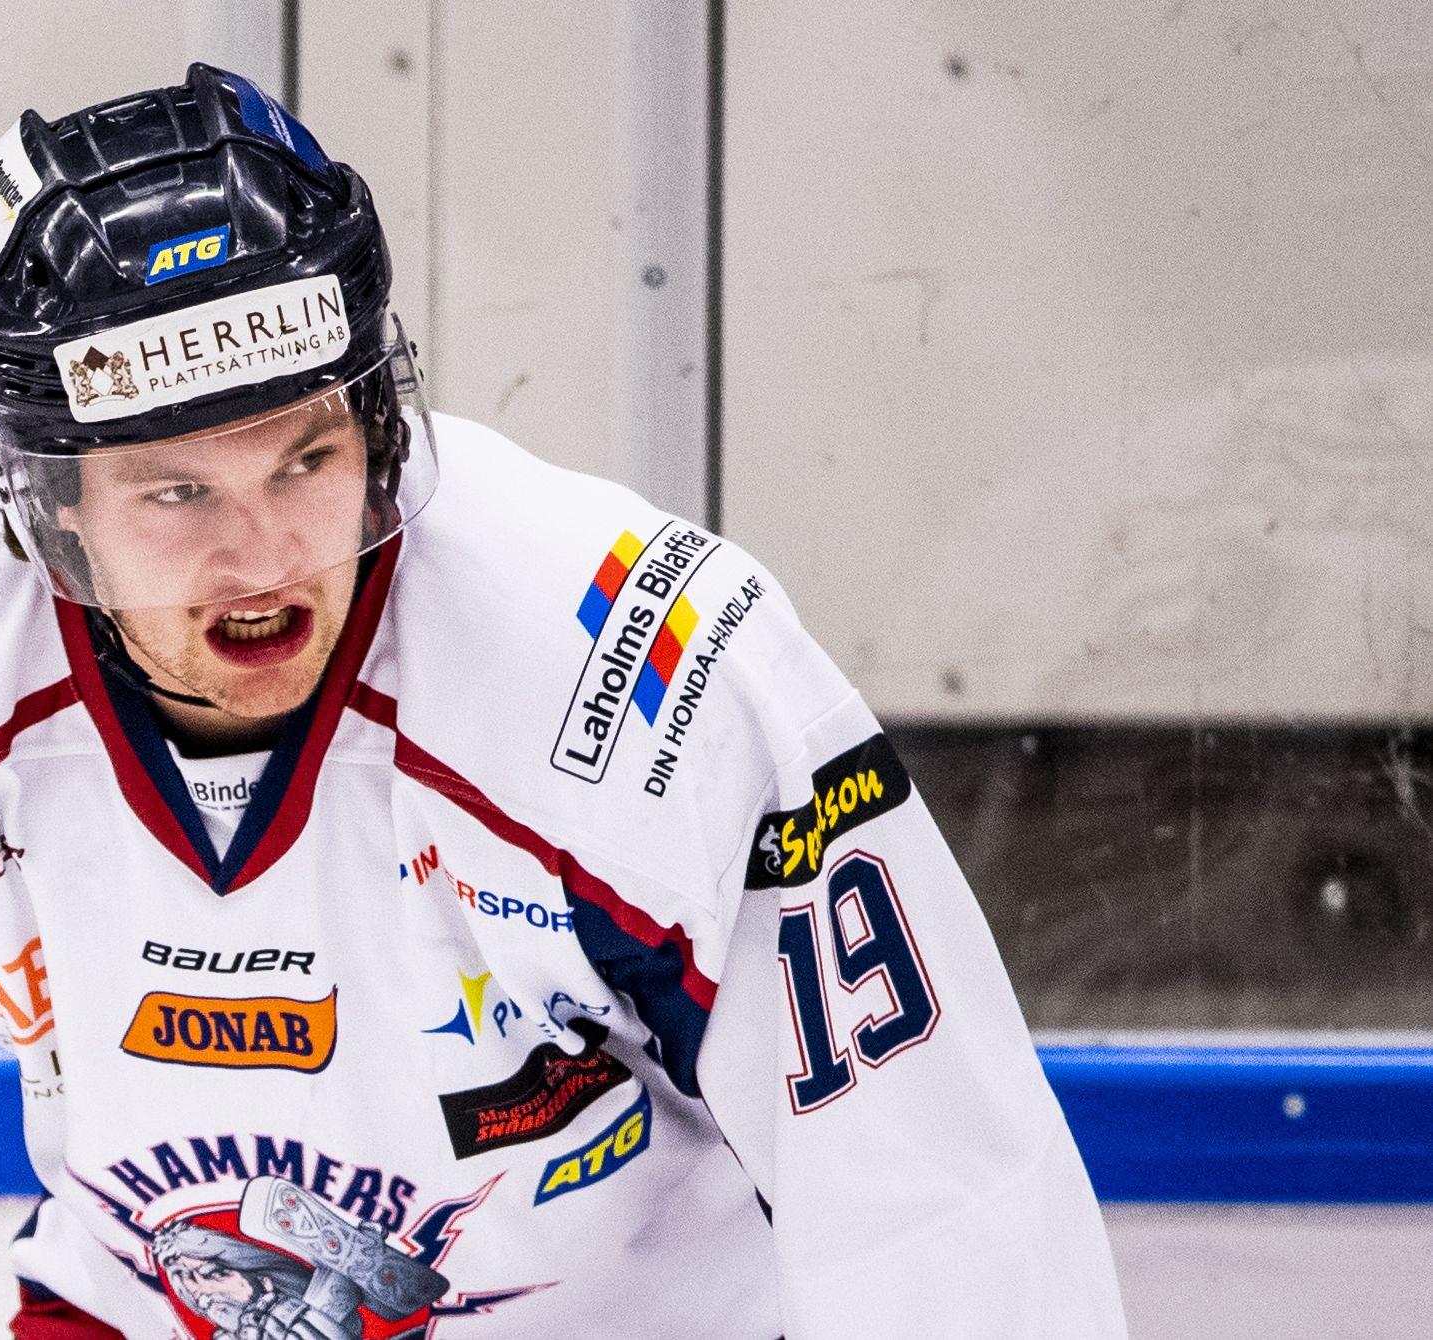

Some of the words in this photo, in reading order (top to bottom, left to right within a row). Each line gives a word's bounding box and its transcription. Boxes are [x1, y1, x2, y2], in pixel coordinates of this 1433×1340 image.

[149, 234, 222, 276] ATG
[139, 287, 341, 371] HERRLIN
[149, 334, 321, 392] PLATTSÄTTNING
[327, 325, 346, 345] AB
[565, 604, 655, 767] Laholms
[635, 529, 709, 600] Bilaffär
[644, 753, 678, 798] DIN
[665, 575, 766, 747] HONDA-HANDLAR
[141, 940, 316, 975] BAUER
[778, 848, 942, 1115] 19
[152, 1004, 315, 1057] JONAB
[107, 1133, 417, 1232] HAMMERS
[542, 1110, 645, 1193] ATG
